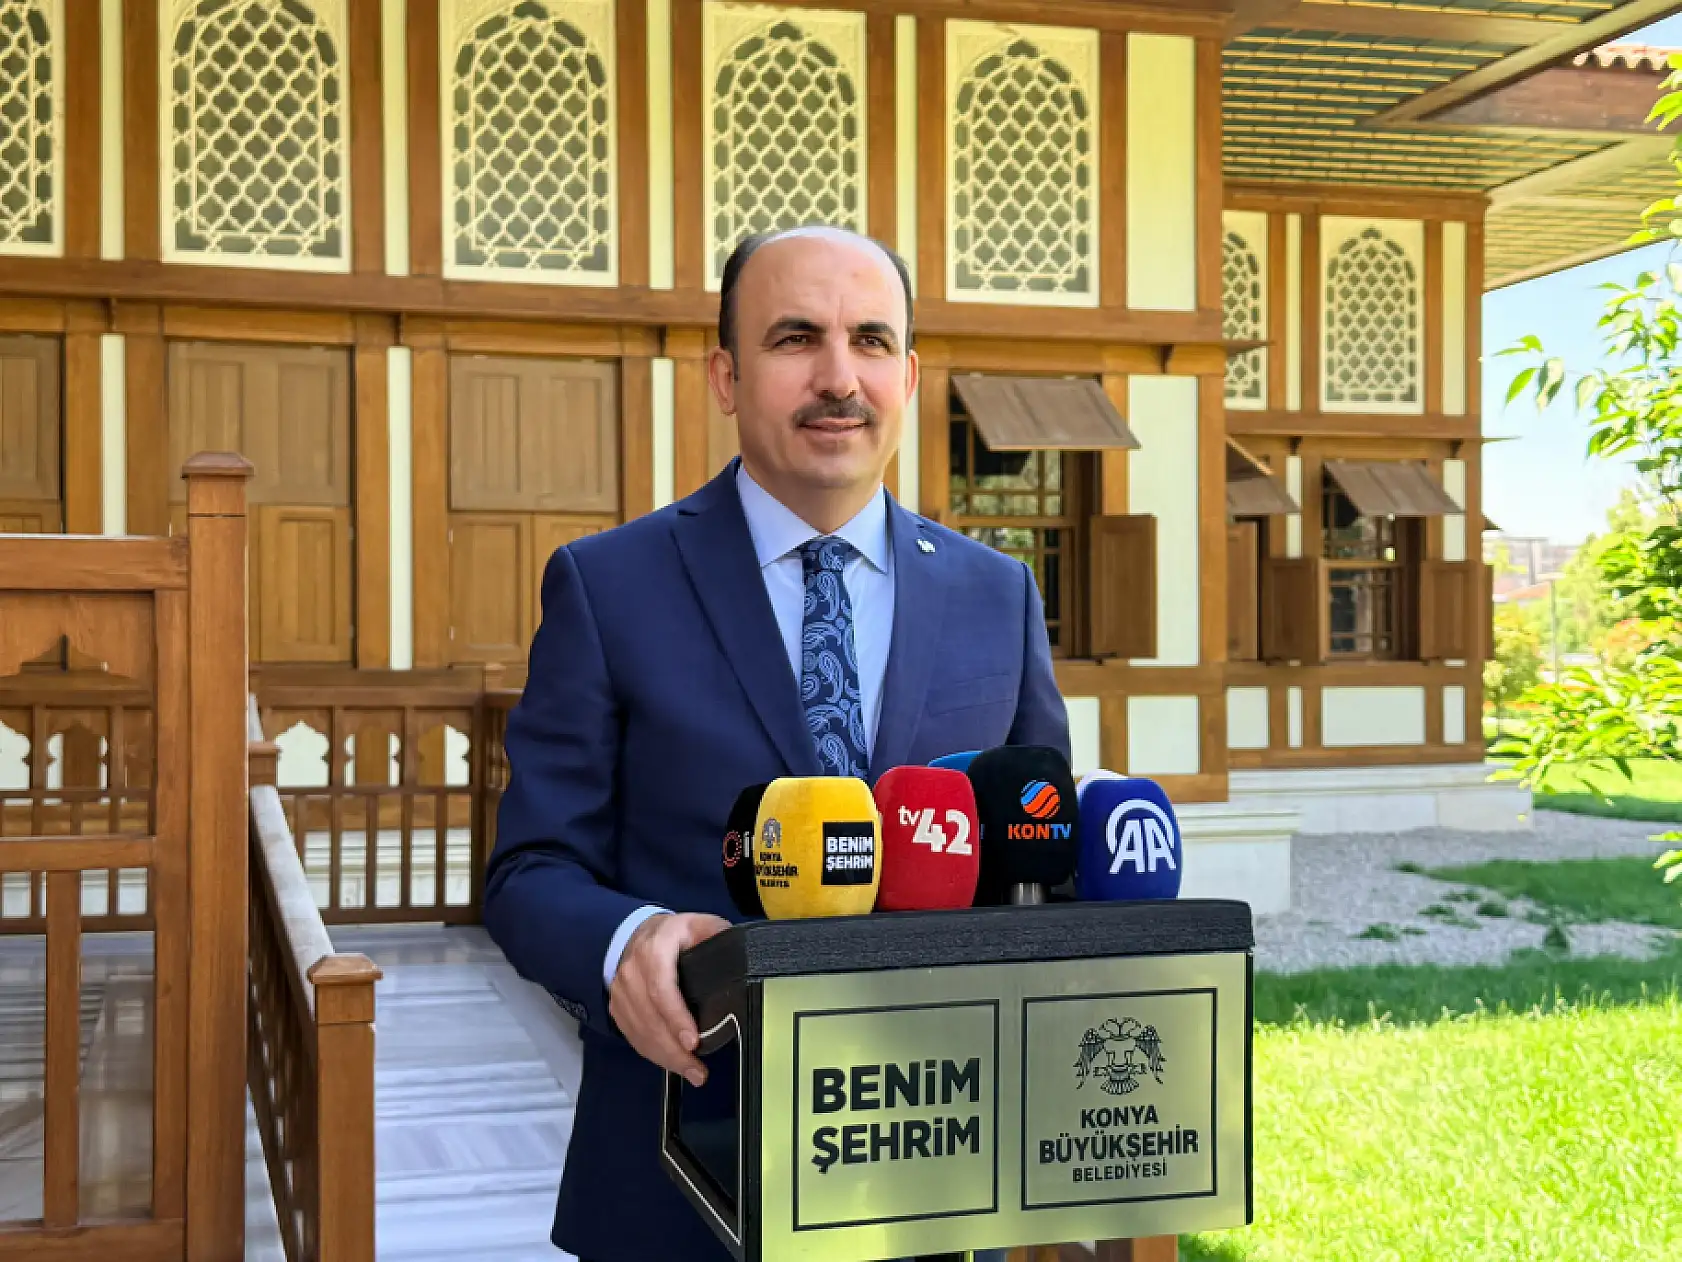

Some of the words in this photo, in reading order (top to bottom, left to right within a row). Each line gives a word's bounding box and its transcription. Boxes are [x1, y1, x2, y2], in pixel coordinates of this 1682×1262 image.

[1007, 823, 1072, 840] KONTV
[1108, 816, 1177, 875] AA
[1081, 1103, 1159, 1129] KONYA
[1039, 1123, 1199, 1165] BÜYÜKŞEHİR
[1072, 1157, 1168, 1183] BELEDİYESİ
